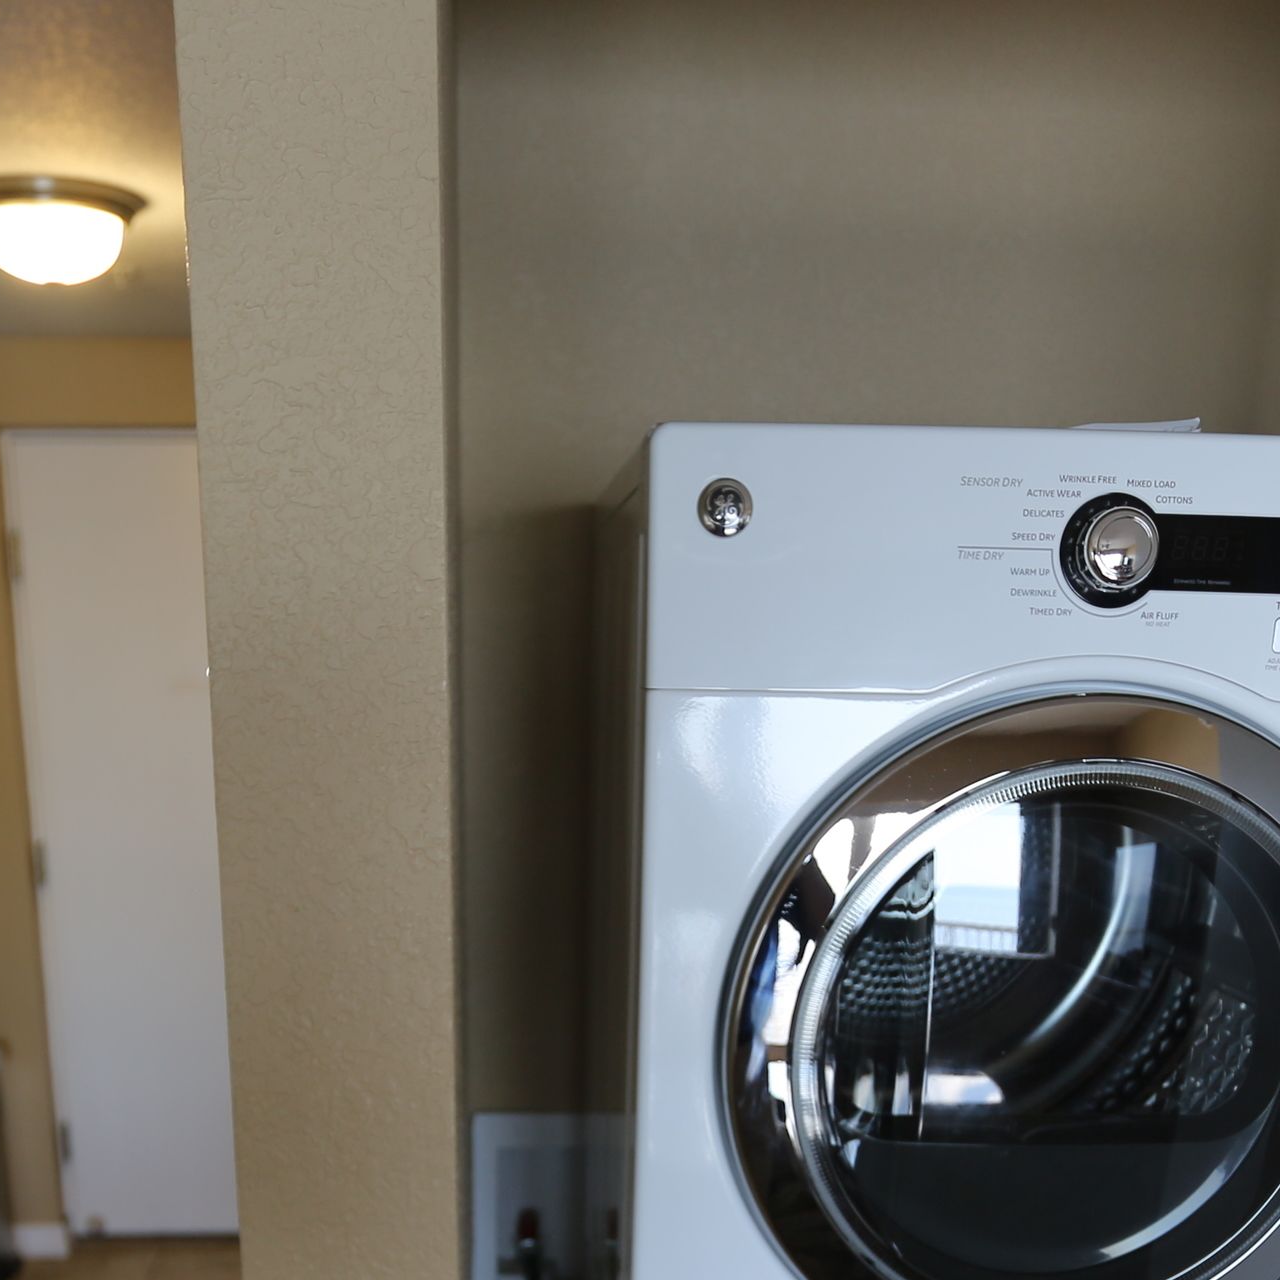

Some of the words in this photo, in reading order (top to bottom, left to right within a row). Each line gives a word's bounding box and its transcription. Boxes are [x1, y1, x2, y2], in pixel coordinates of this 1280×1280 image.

[960, 476, 1000, 488] SENSOR
[1002, 477, 1024, 489] DRY
[1059, 474, 1096, 484] WRINKLE
[1098, 475, 1118, 485] FREE
[1127, 478, 1153, 489] MIXED
[1154, 479, 1177, 489] LOAD
[1026, 488, 1055, 498] ACTIVE
[1057, 489, 1082, 499] WEAR
[1155, 495, 1193, 505] COTTONS
[1022, 508, 1065, 519] DELICATES
[1011, 532, 1037, 542] SPEED
[1039, 532, 1056, 542] DRY
[958, 550, 981, 561] TIME
[983, 551, 1004, 561] DRY
[1010, 567, 1037, 577] WARM
[1038, 567, 1050, 577] UP
[1010, 587, 1057, 598] DEWRINKLE
[1029, 607, 1054, 617] TIMED
[1055, 607, 1073, 617] DRY
[1140, 611, 1154, 621] AIR
[1156, 611, 1179, 622] FLUFF
